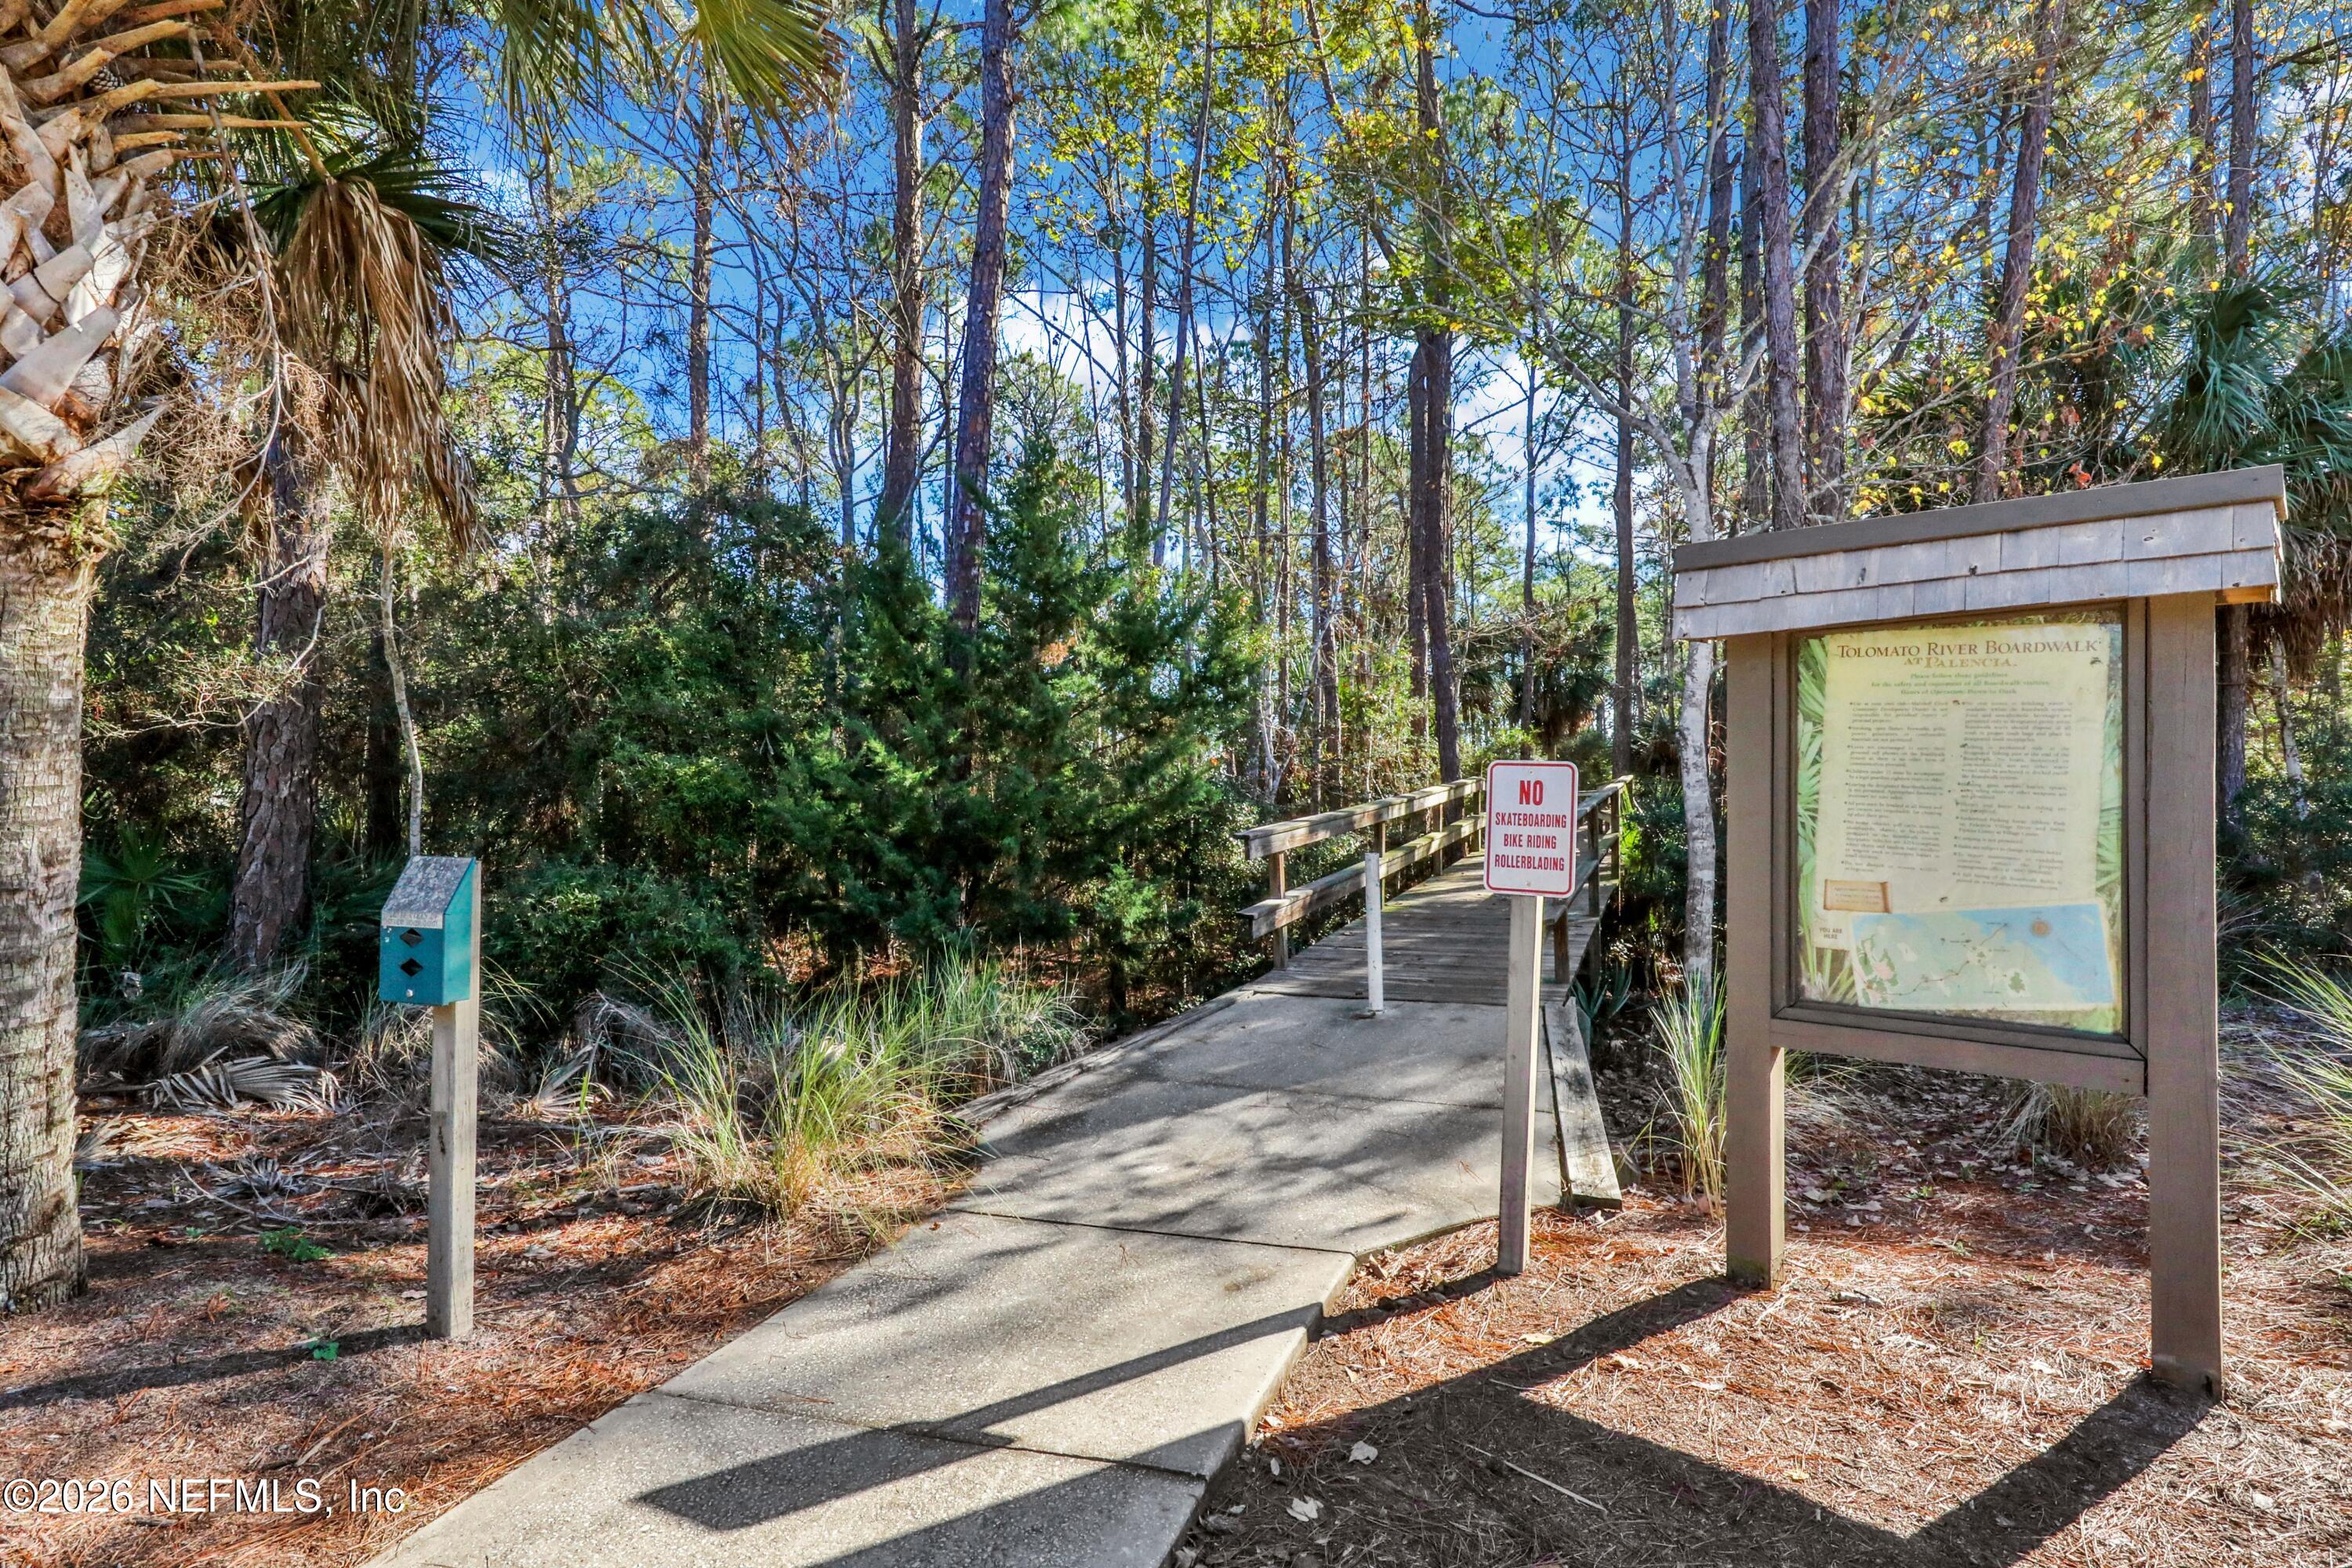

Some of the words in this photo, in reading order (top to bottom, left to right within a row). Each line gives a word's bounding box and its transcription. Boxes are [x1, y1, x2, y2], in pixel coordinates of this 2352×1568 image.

[1838, 645, 1920, 659] TOLOMATO
[1927, 642, 1977, 656] RIVER
[1985, 640, 2098, 654] BOARDWALK
[1904, 657, 1922, 666] AT
[1519, 780, 1544, 806] NO
[1495, 812, 1566, 828] SKATEBOARDING
[1504, 834, 1523, 848] BIKE
[1526, 835, 1557, 849] RIDING
[1494, 855, 1565, 871] ROLLERBLADING
